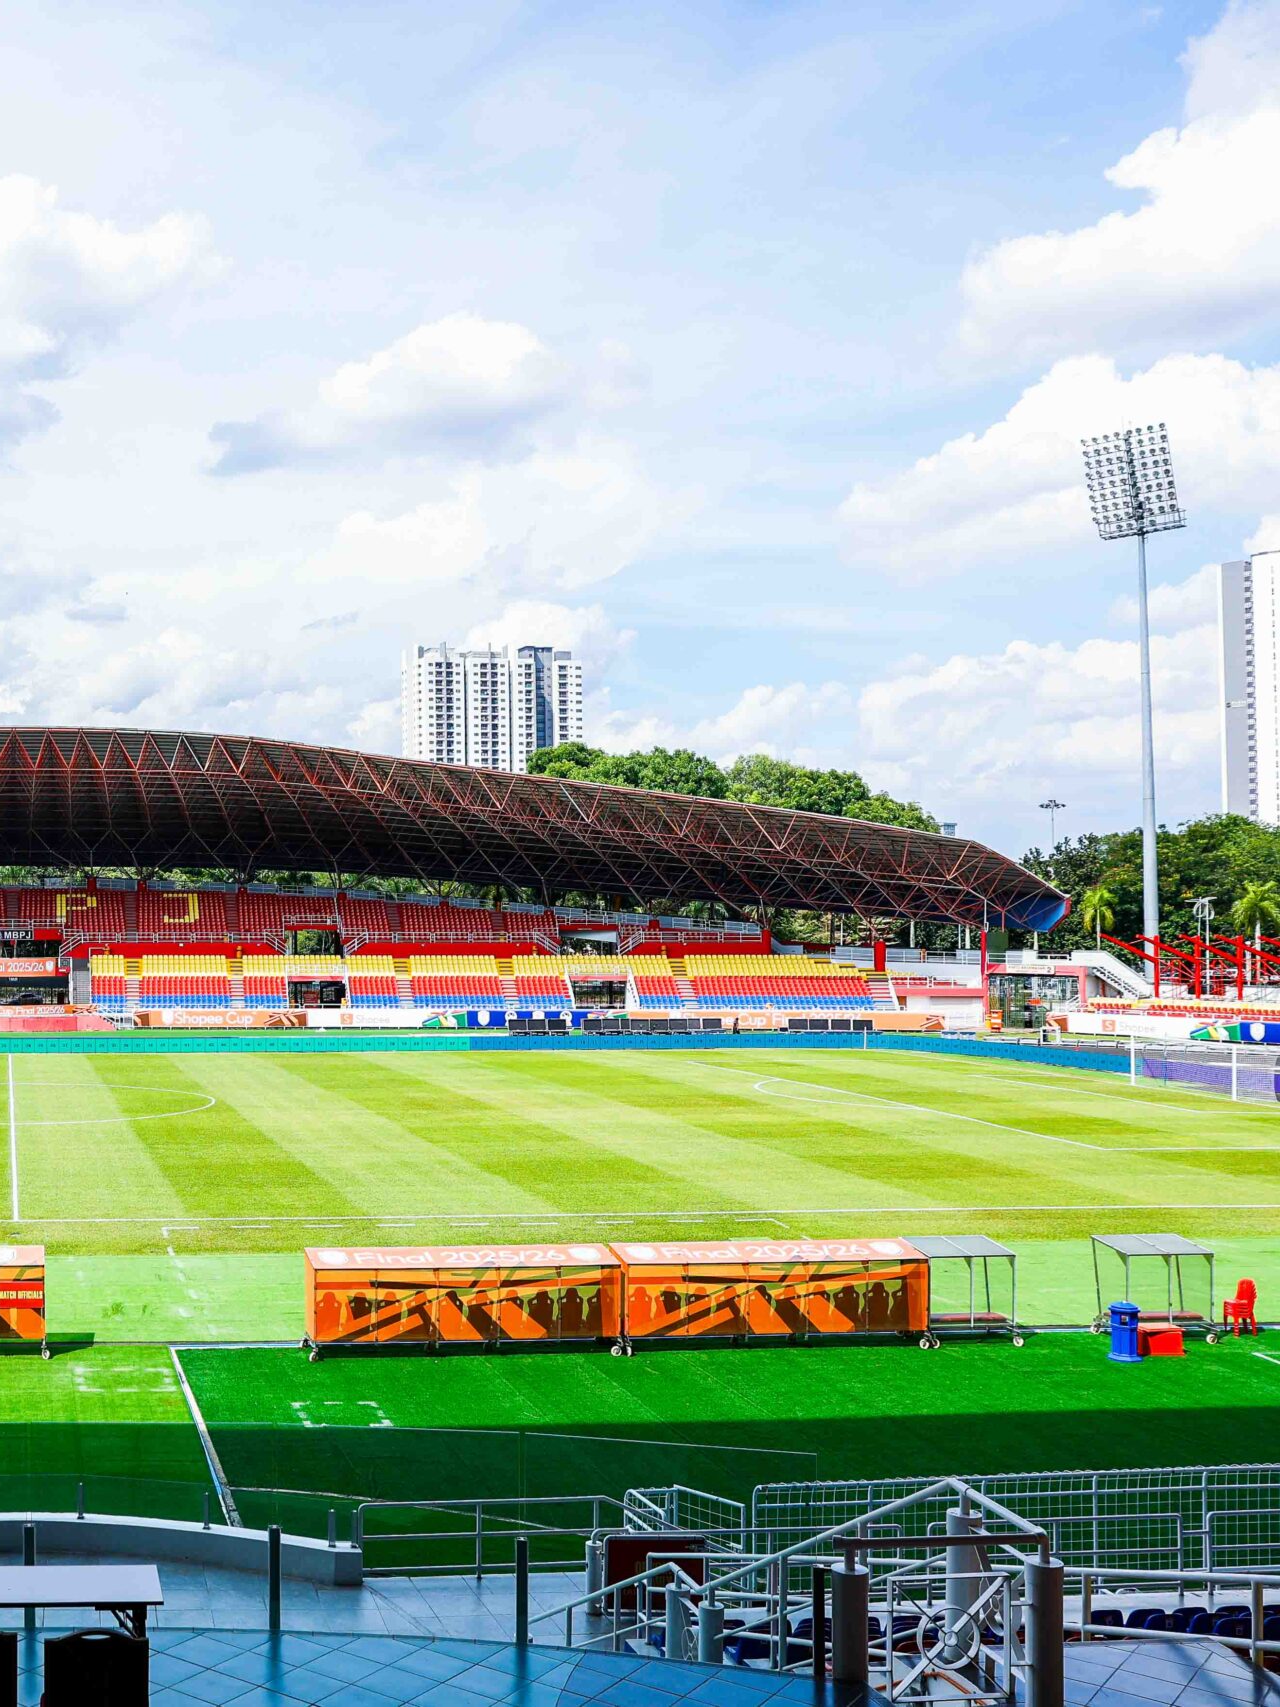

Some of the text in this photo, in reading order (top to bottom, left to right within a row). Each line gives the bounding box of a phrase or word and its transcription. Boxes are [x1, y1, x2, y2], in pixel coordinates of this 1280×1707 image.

[4, 931, 31, 939] MBPJ
[7, 963, 44, 972] 2025/26
[16, 1006, 34, 1015] Final
[37, 1005, 65, 1015] 2025/26
[176, 1011, 253, 1026] Shopee Cup
[356, 1014, 390, 1025] Shopee
[738, 1013, 766, 1026] Cup
[1119, 1021, 1154, 1033] Shopee
[354, 1250, 565, 1265] Final 2025/26
[663, 1244, 869, 1260] Final 2025/26
[0, 1291, 43, 1299] MATCH OFFICIALS
